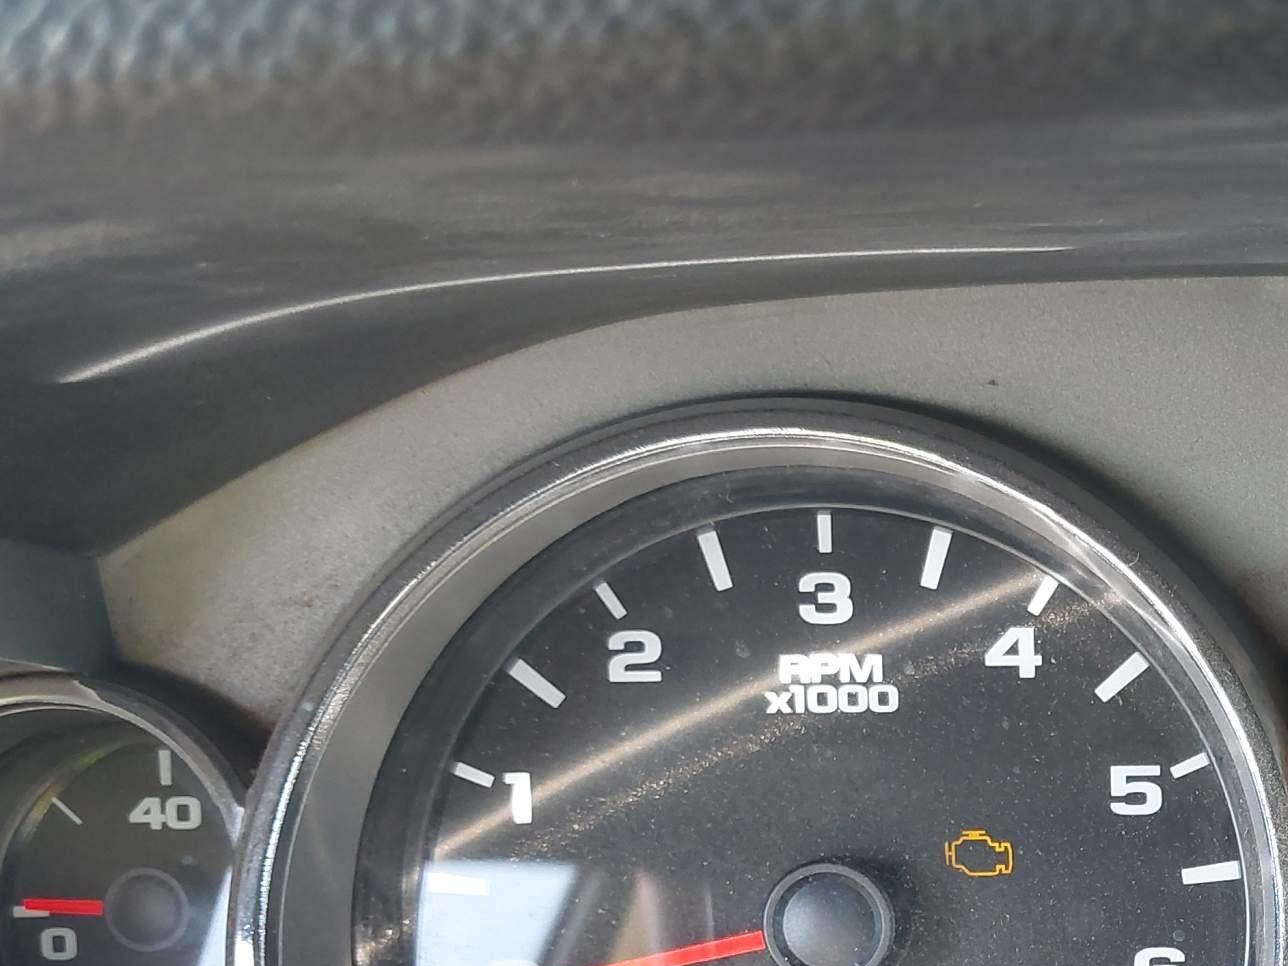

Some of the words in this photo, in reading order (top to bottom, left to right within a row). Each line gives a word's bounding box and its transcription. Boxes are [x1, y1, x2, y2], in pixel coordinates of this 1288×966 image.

[798, 572, 854, 625] 3
[607, 630, 662, 683] 2
[778, 653, 883, 684] RPM
[984, 627, 1043, 679] 4
[764, 684, 899, 714] x1000
[128, 796, 202, 831] 40
[502, 771, 533, 825] 1
[1109, 765, 1163, 816] 5
[40, 927, 78, 961] 0
